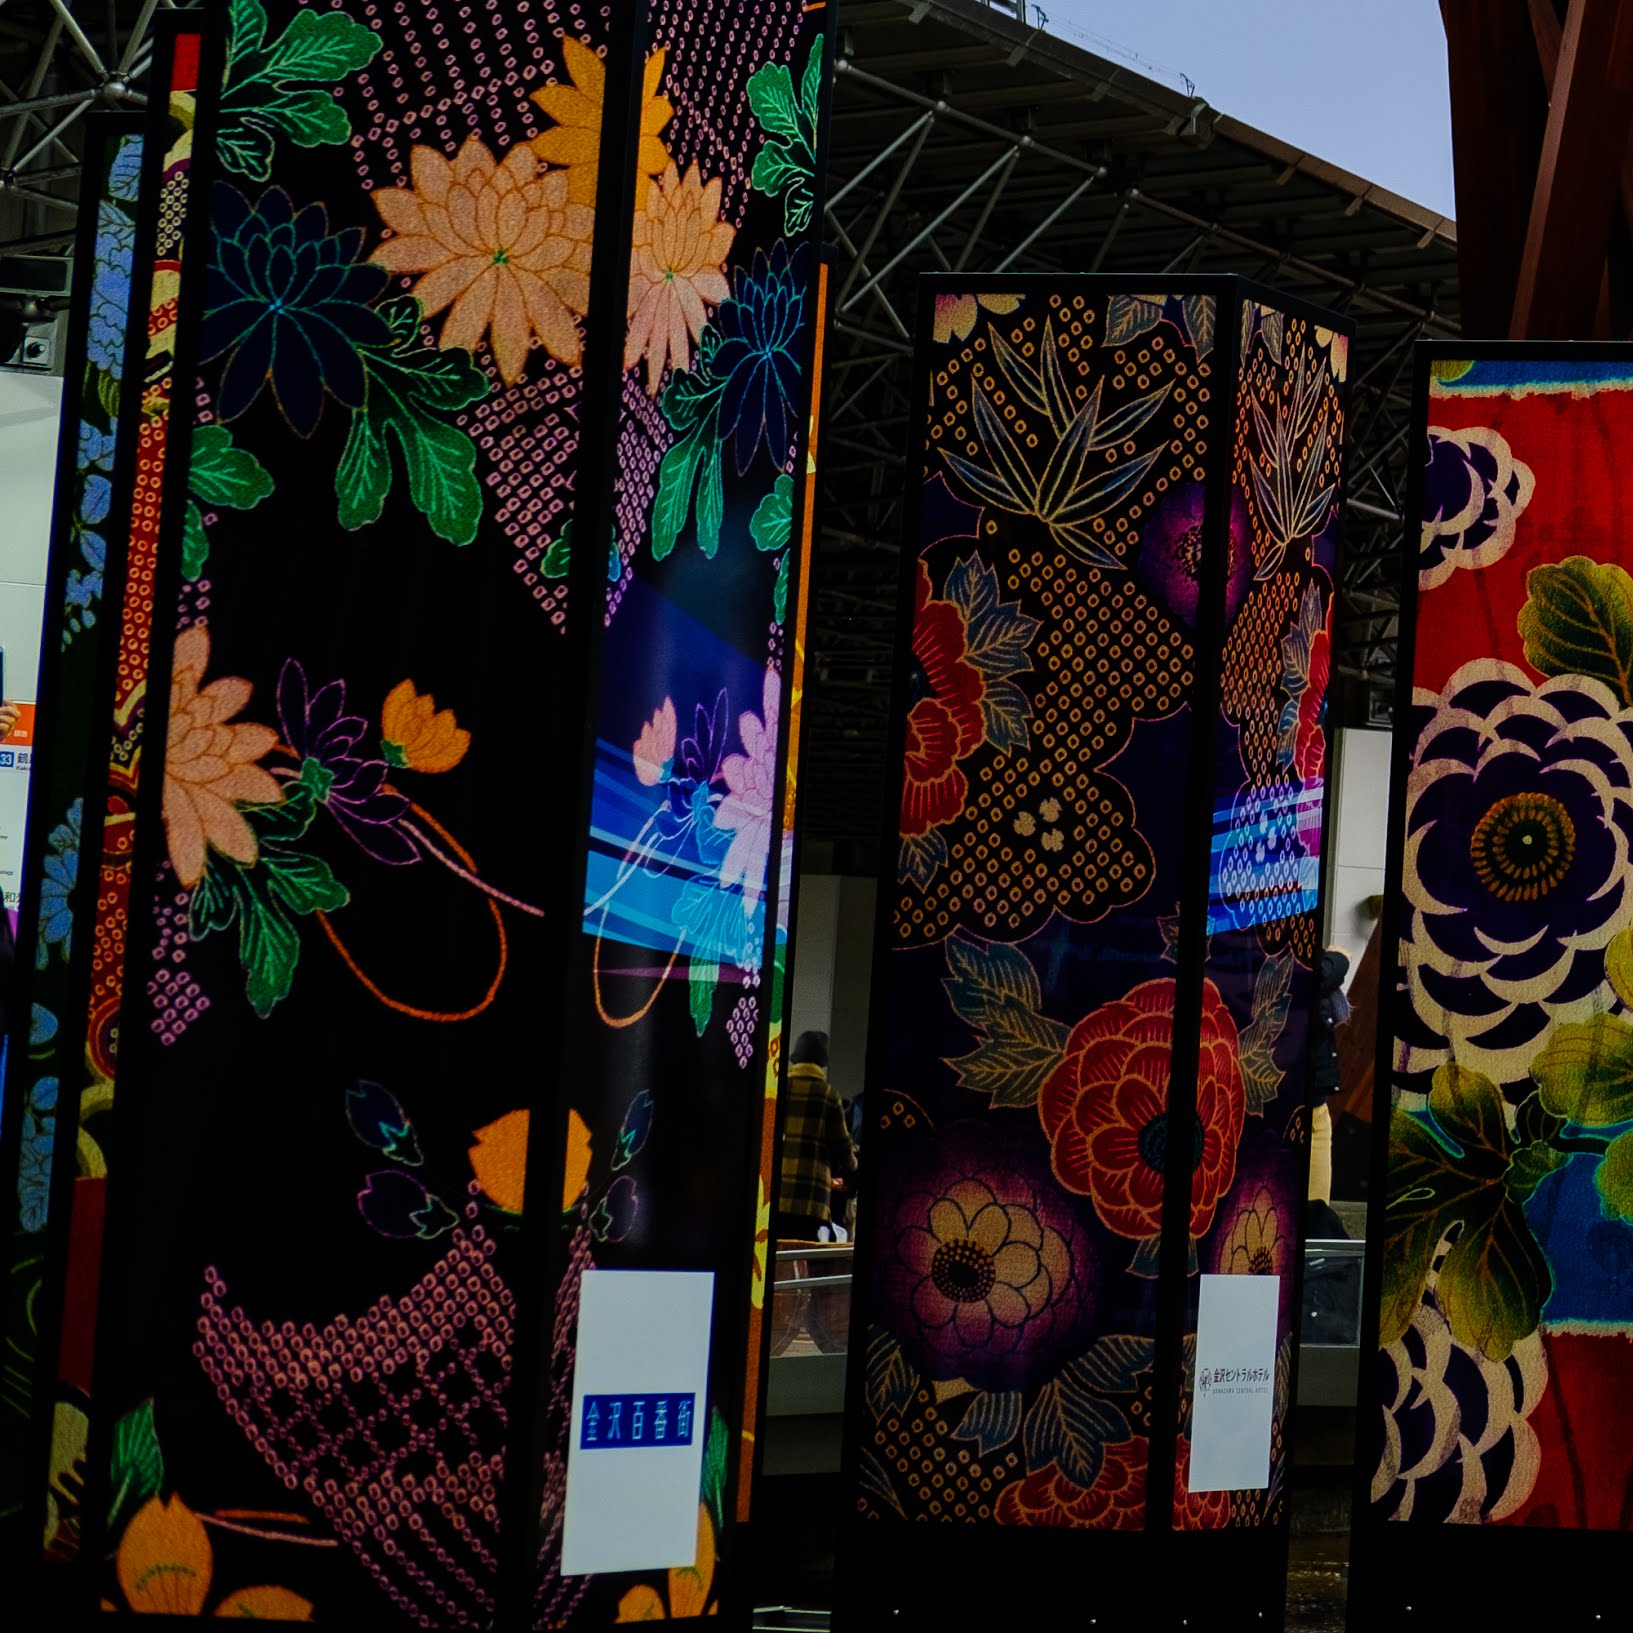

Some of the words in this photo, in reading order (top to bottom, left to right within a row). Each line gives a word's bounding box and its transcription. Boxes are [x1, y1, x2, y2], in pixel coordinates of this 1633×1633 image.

[1213, 1368, 1270, 1383] 金沢セントラルホテル
[585, 1399, 693, 1442] 金沢百番街
